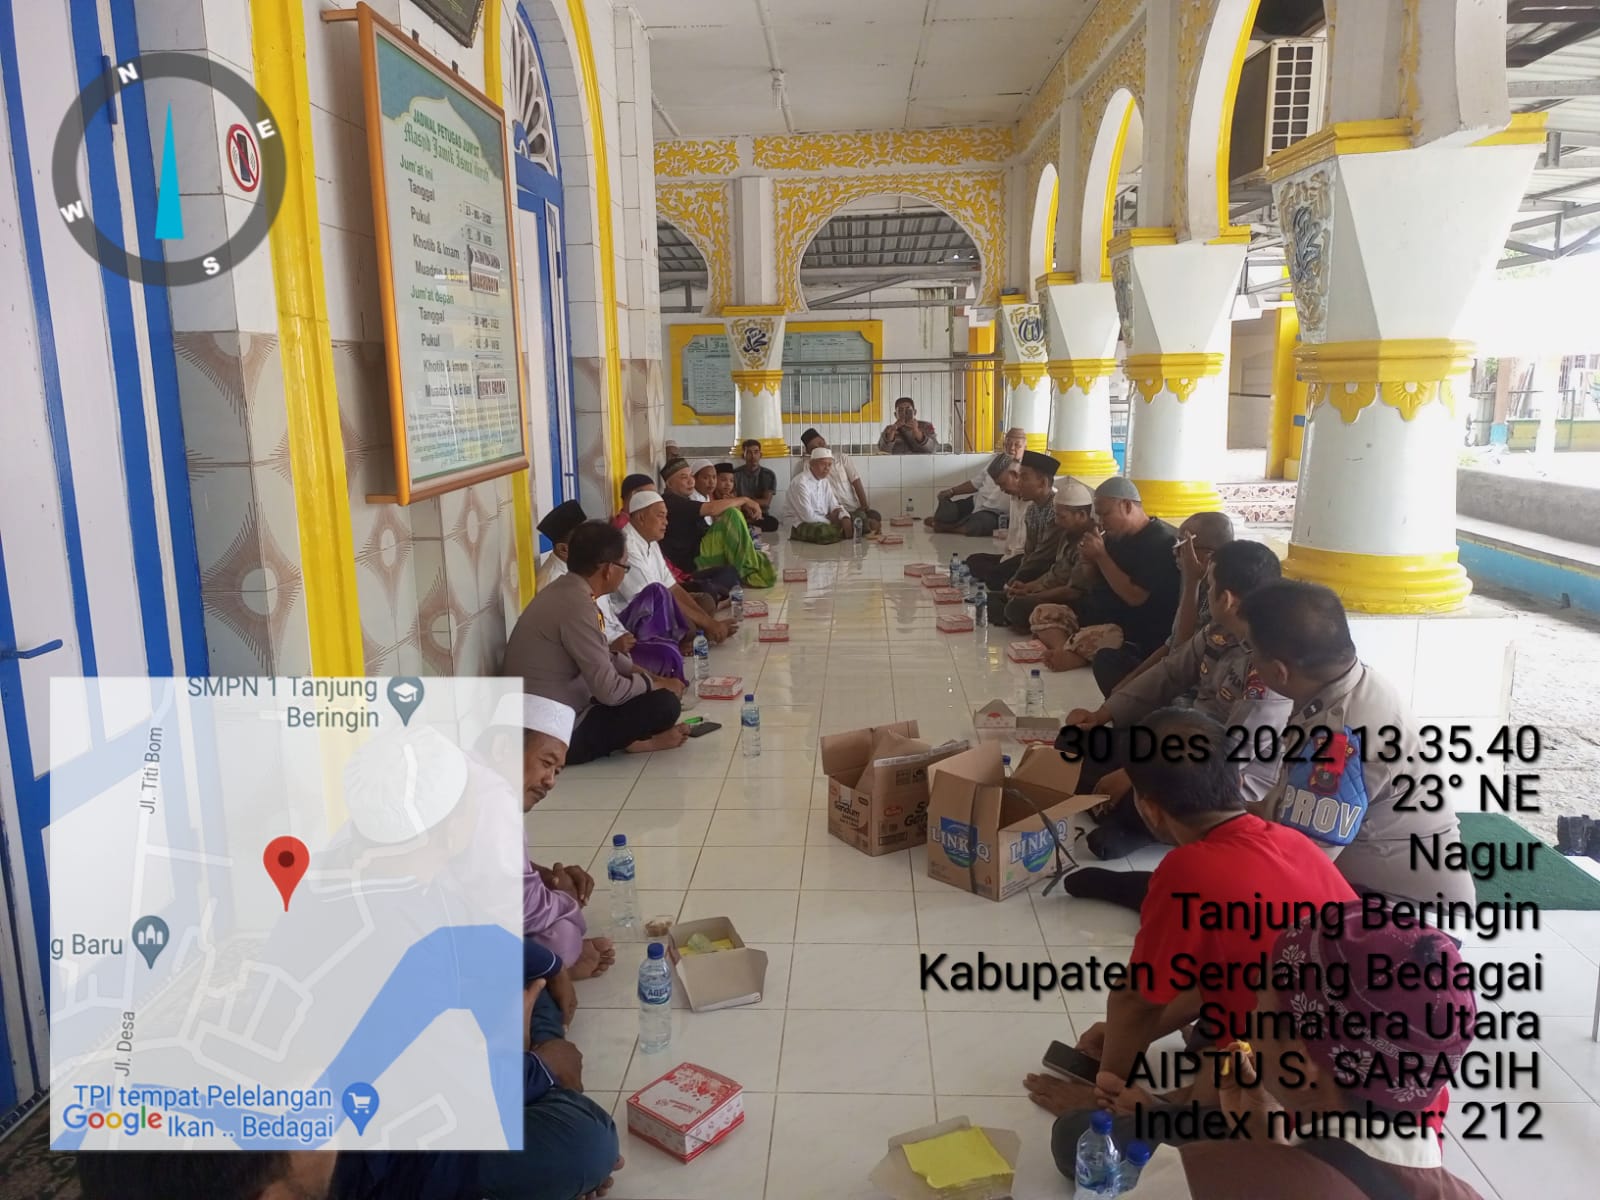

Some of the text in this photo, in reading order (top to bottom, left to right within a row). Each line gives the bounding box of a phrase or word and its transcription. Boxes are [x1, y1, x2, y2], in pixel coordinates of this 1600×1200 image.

[408, 178, 435, 202] Tanggal
[410, 206, 431, 225] Pukul
[434, 288, 455, 305] depan
[419, 306, 445, 325] Tanggal
[421, 333, 440, 347] Pukul
[423, 359, 446, 372] Khotib
[1279, 784, 1362, 838] PROV
